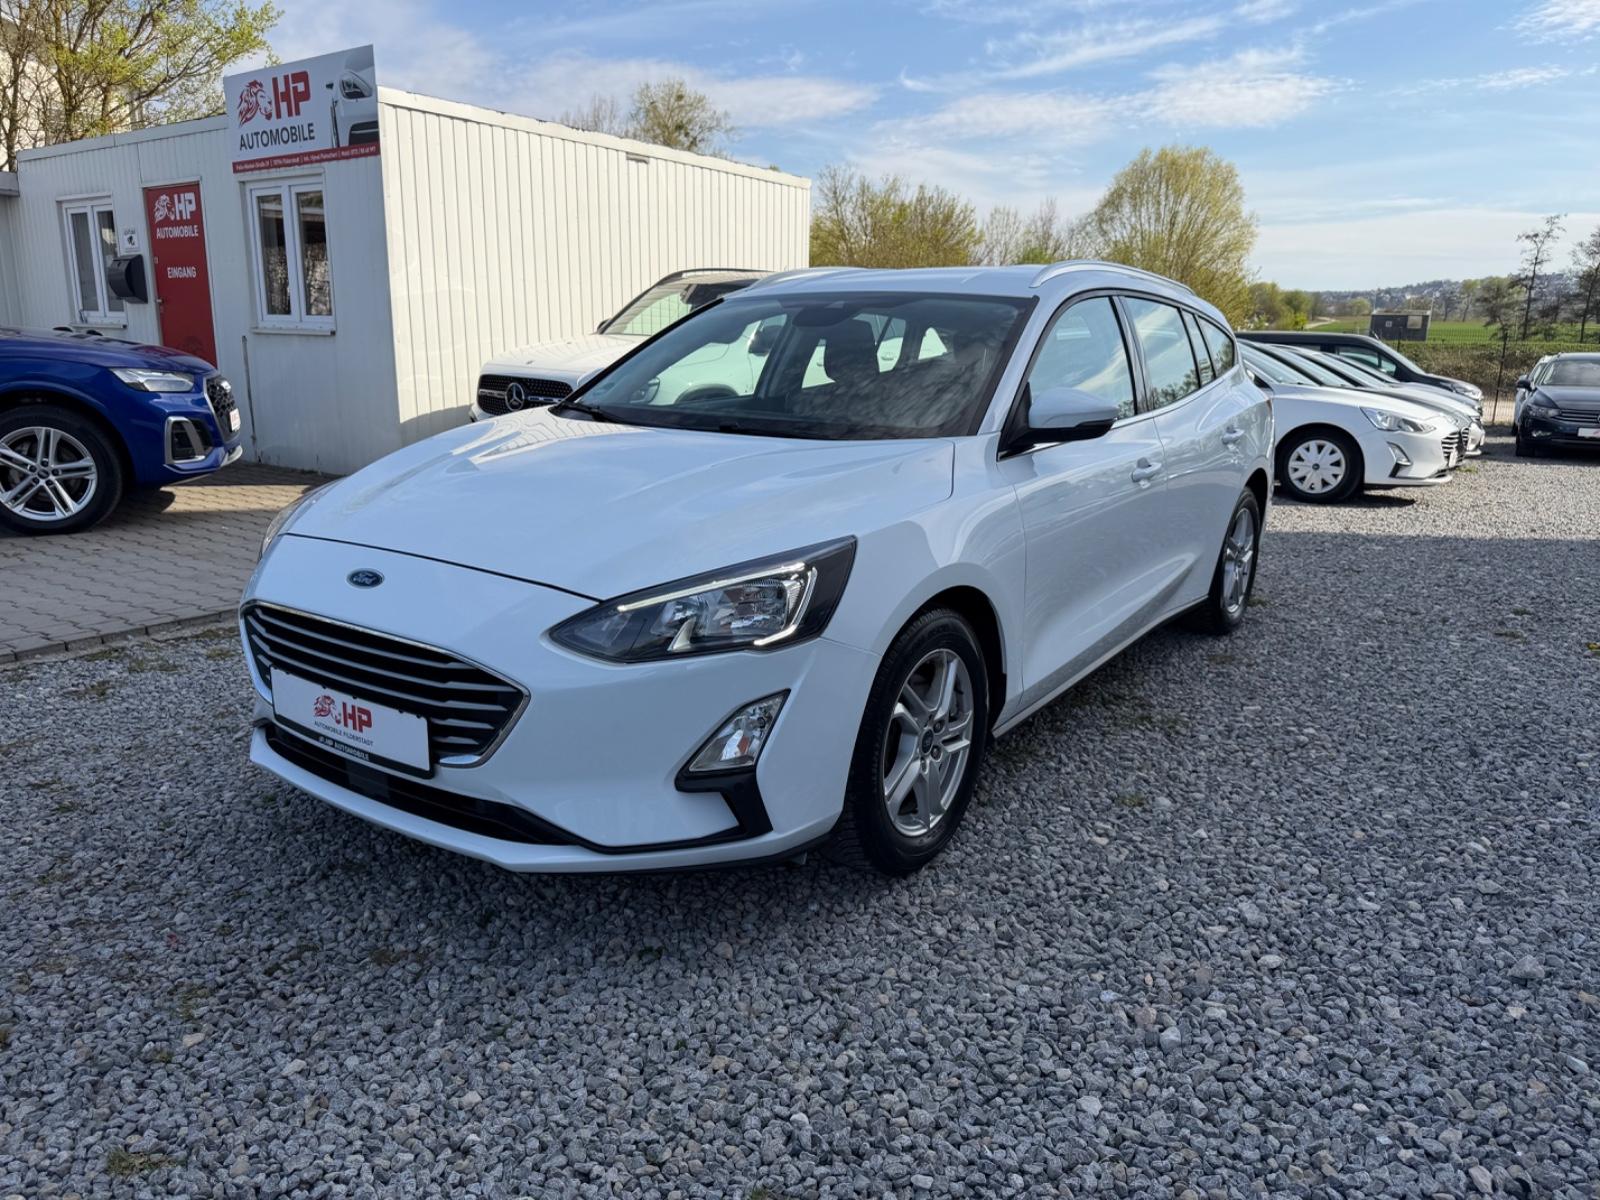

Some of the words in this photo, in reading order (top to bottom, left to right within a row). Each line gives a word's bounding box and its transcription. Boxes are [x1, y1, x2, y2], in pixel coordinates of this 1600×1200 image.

[271, 70, 311, 120] HP
[239, 122, 316, 151] AUTOMOBILE
[173, 191, 197, 220] HP
[156, 225, 199, 239] AUTOMOBILE
[167, 266, 197, 278] EINGANG
[314, 720, 343, 737] AUTOMOBILE
[342, 701, 373, 733] HP
